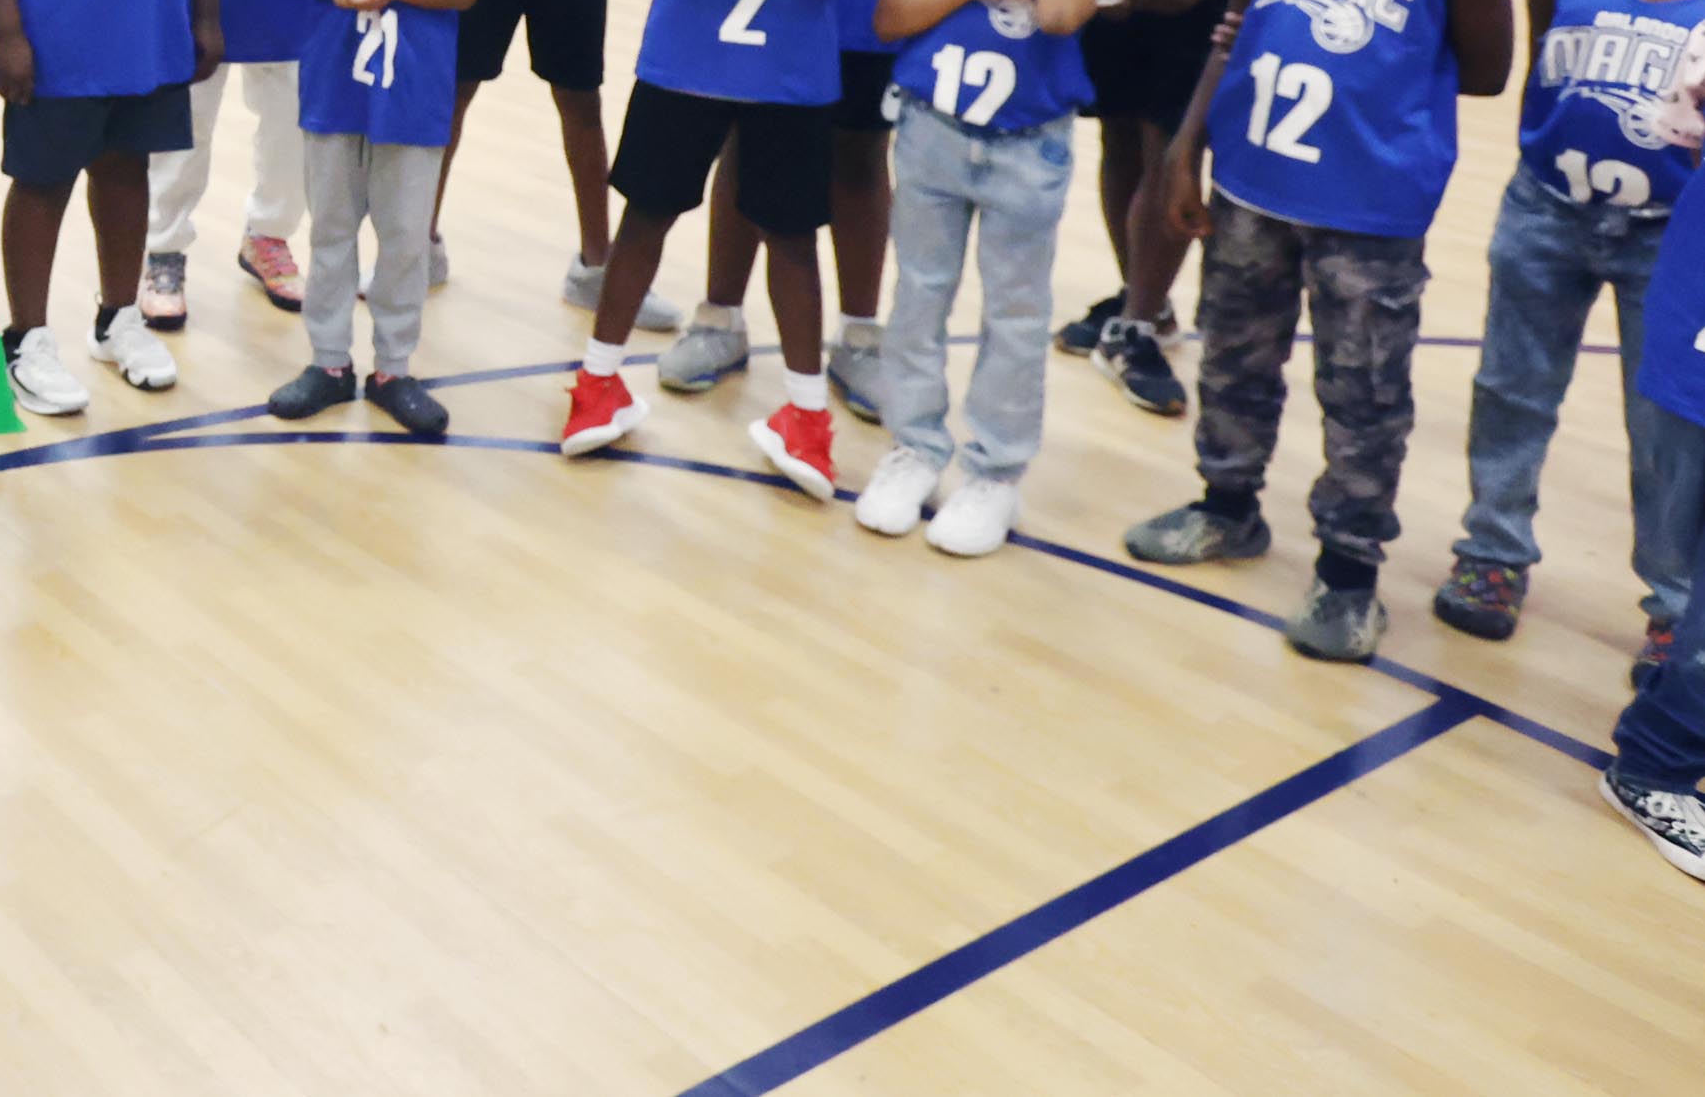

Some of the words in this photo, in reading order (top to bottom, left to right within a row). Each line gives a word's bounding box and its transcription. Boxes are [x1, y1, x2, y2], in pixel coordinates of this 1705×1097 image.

[352, 8, 398, 89] 21
[932, 44, 1017, 126] 12
[1541, 25, 1681, 94] MAG
[1247, 51, 1333, 164] 12
